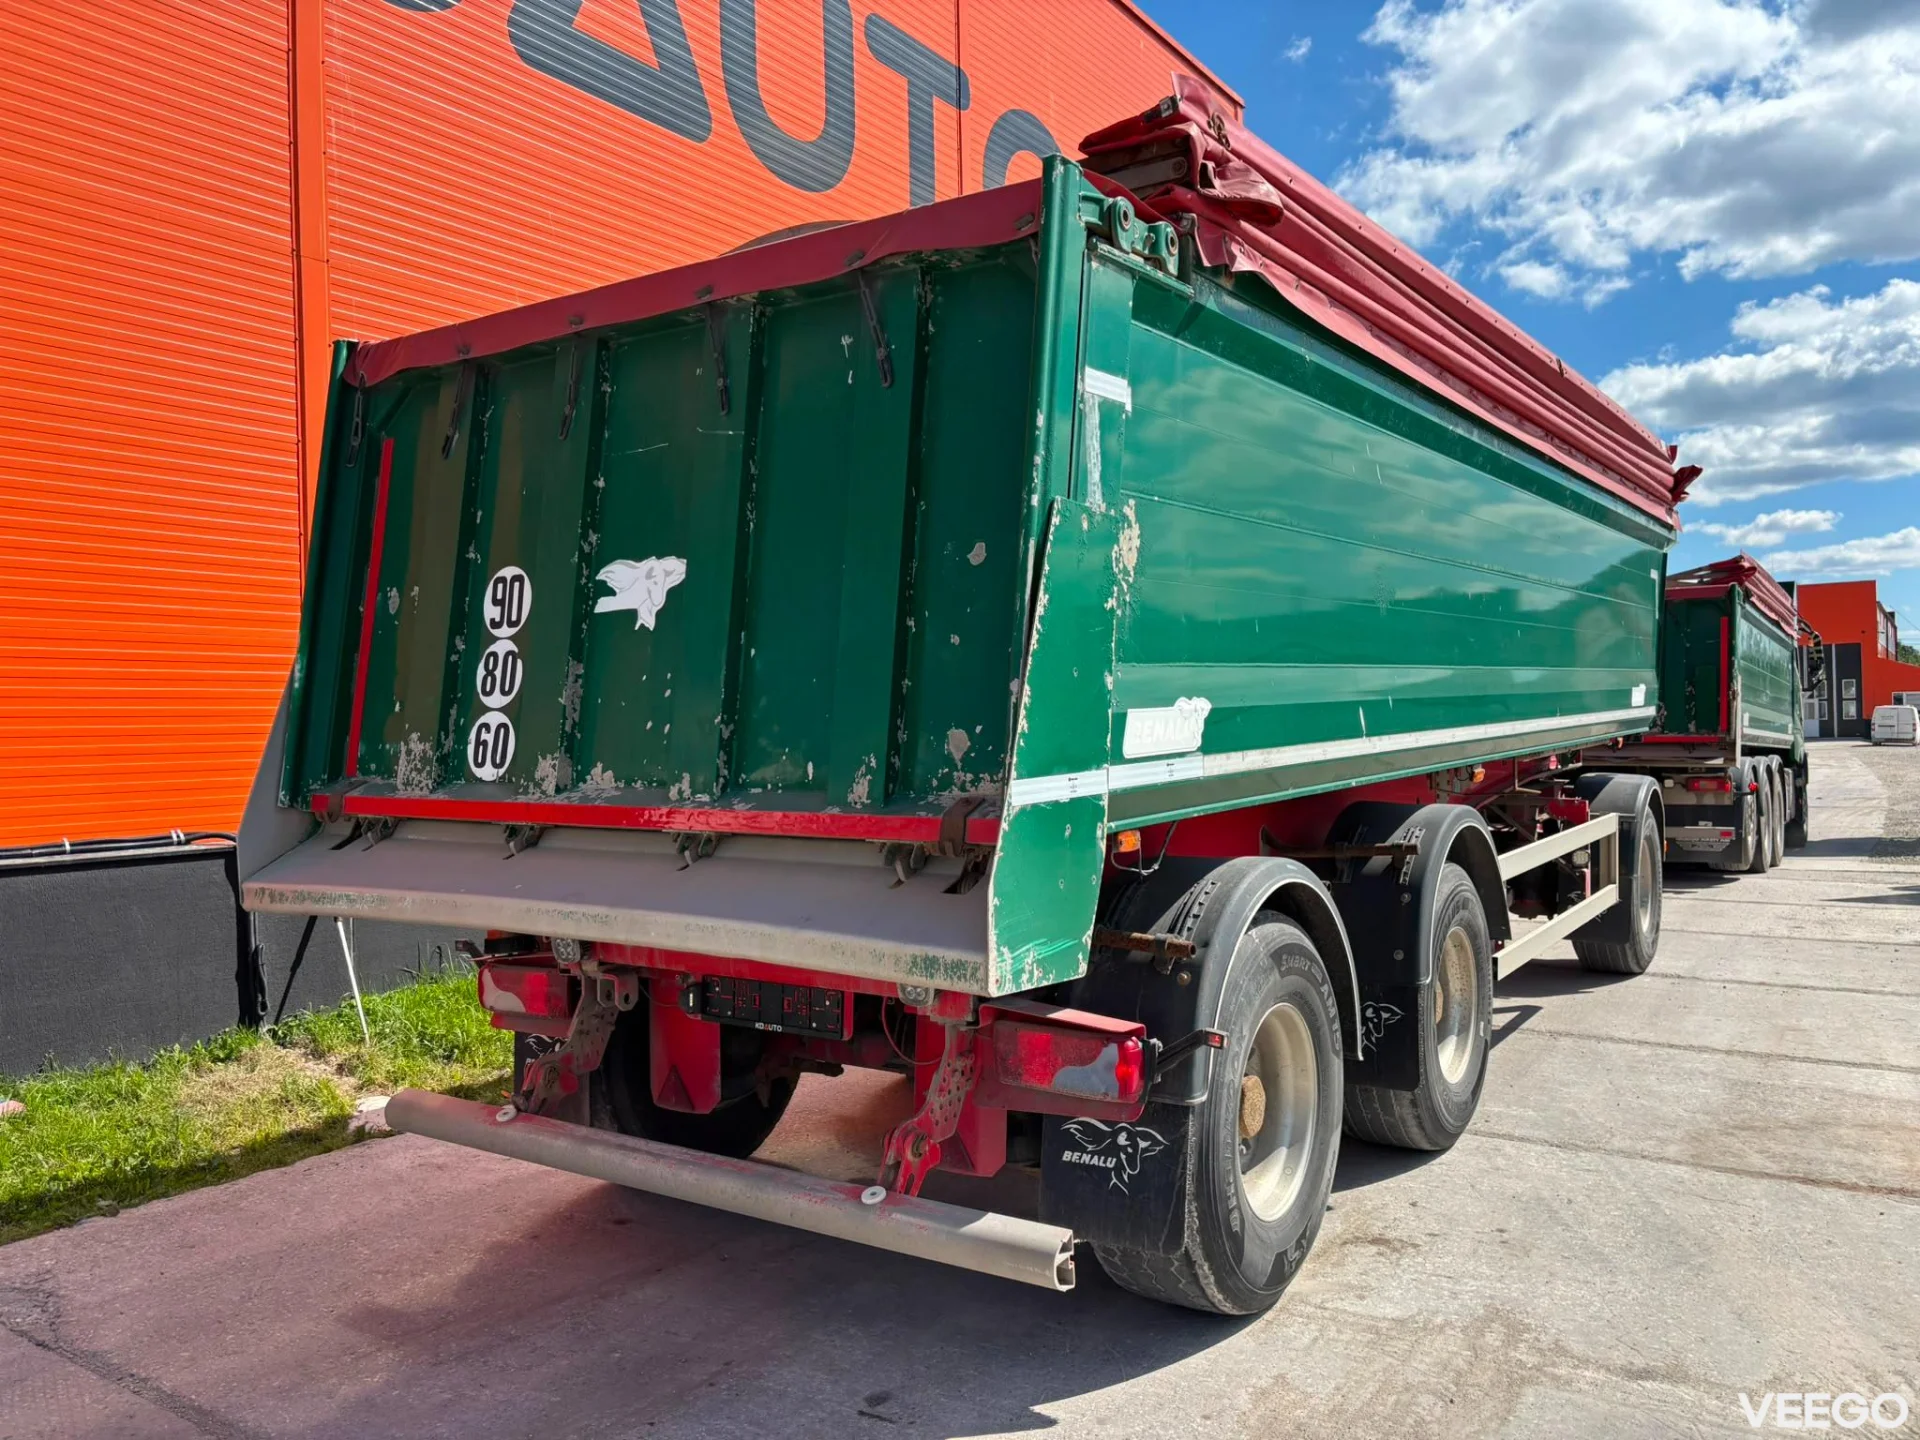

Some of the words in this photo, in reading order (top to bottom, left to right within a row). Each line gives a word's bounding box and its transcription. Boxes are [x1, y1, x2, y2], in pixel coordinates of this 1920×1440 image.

[489, 574, 525, 630] 90
[480, 650, 518, 697] 80
[473, 722, 510, 769] 60
[1062, 1150, 1117, 1168] BENALU
